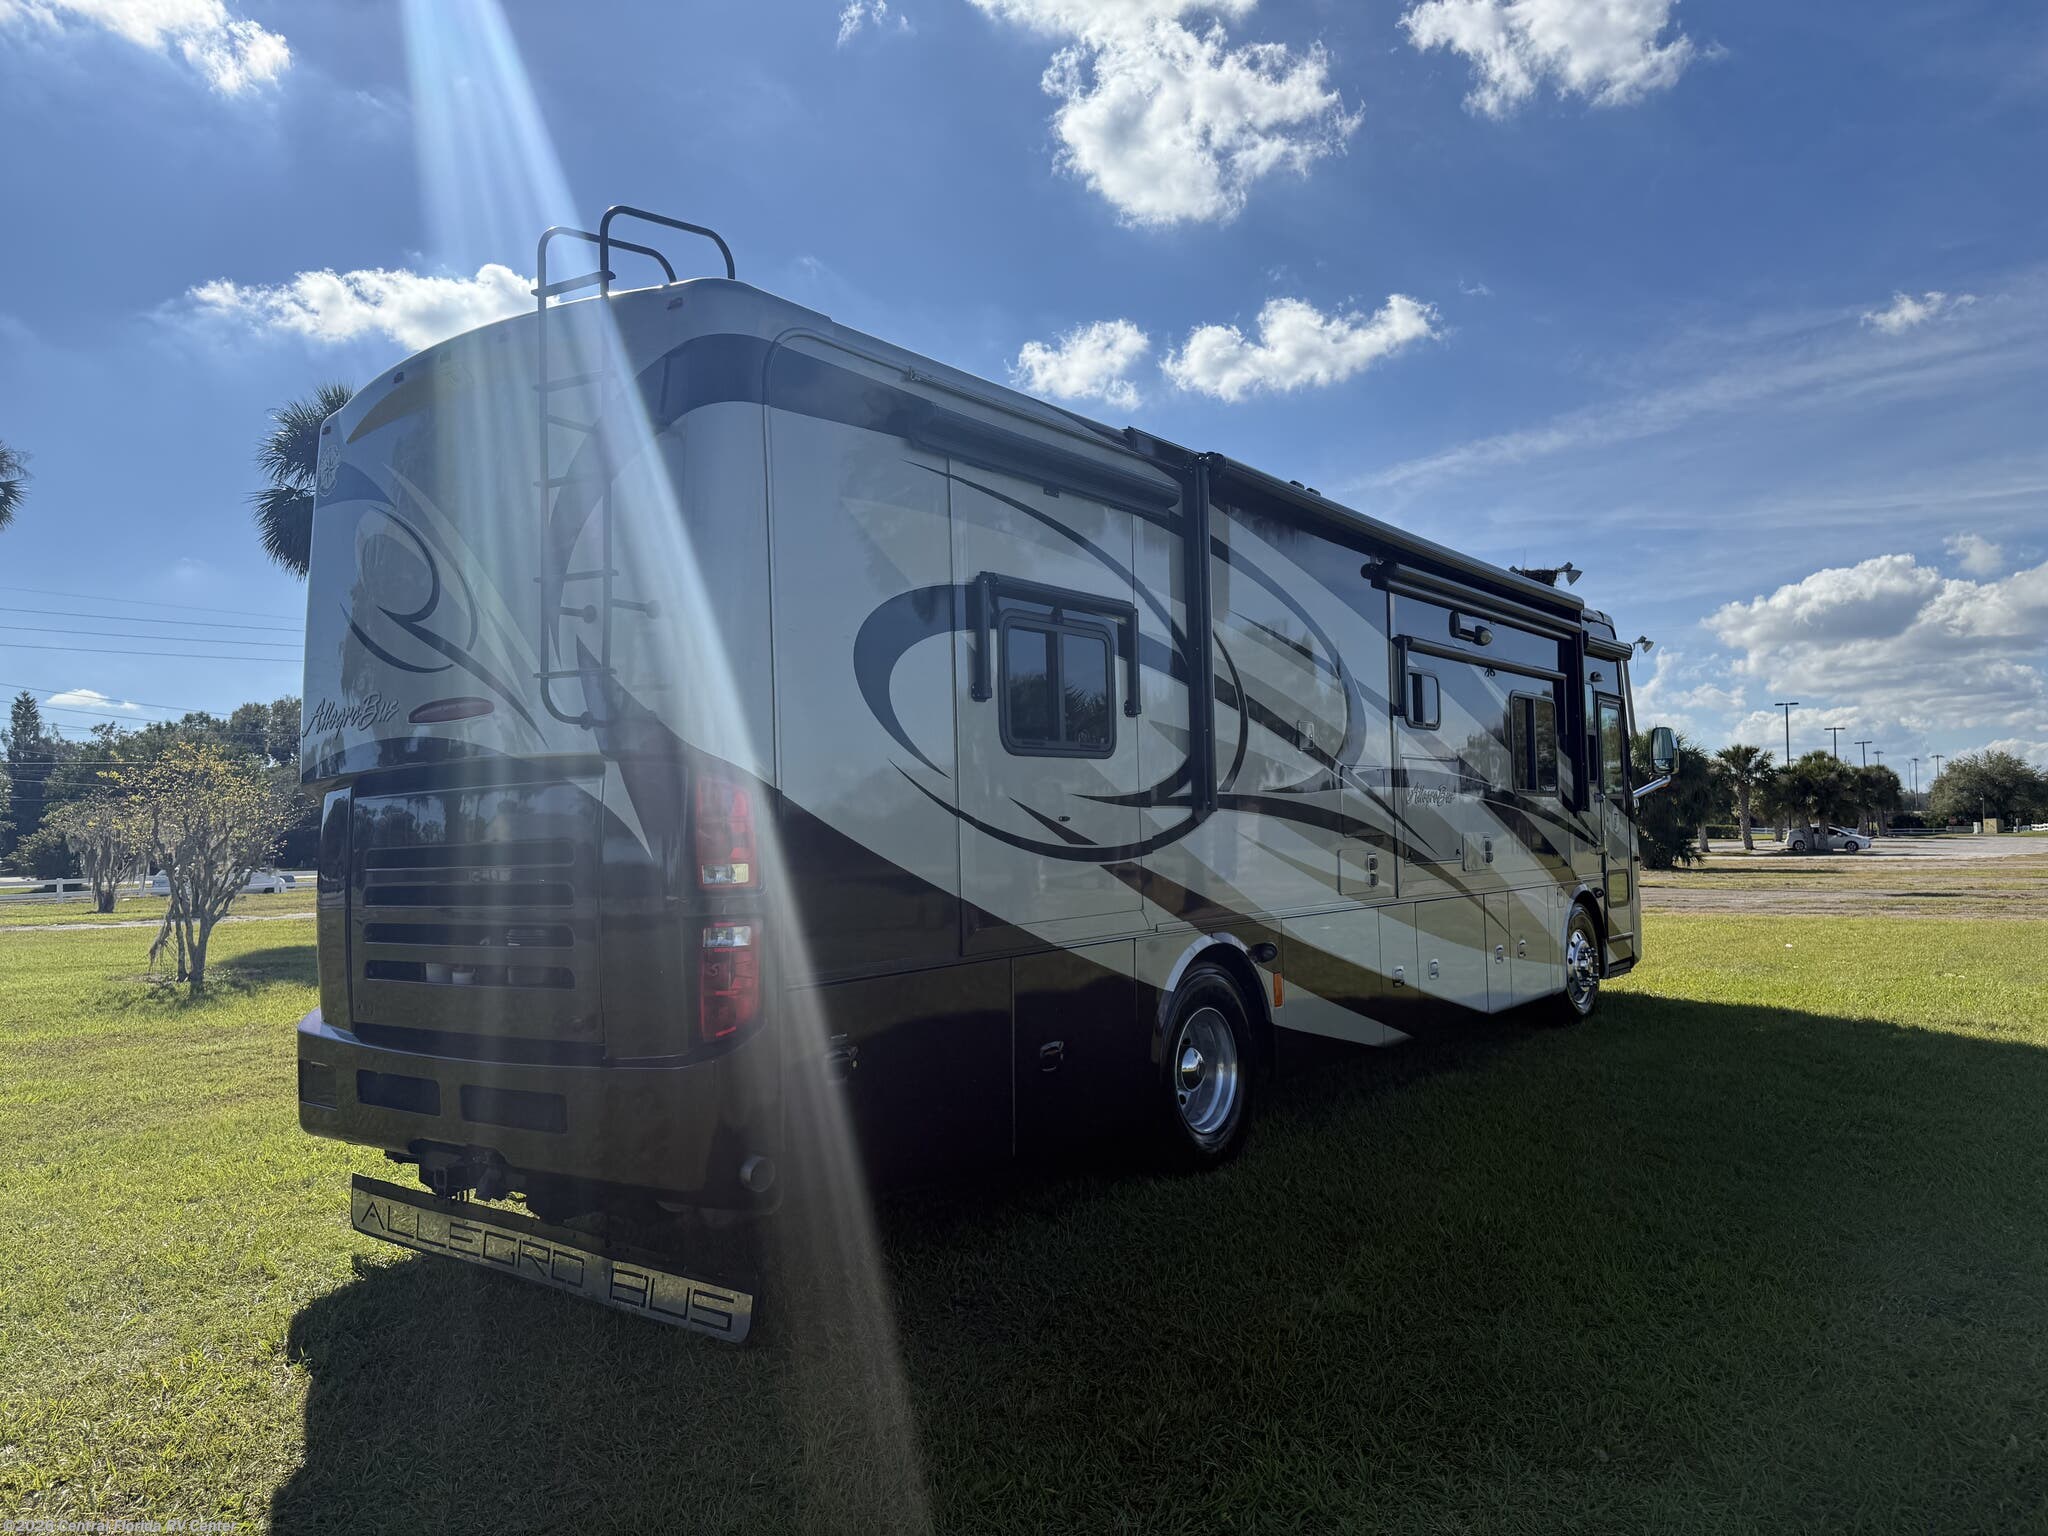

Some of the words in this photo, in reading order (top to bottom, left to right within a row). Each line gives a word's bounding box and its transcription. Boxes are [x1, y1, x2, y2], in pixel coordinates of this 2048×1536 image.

[302, 697, 362, 739] Allegro
[359, 692, 399, 731] Bus
[361, 1201, 585, 1288] ALLEGRO
[610, 1266, 735, 1332] BUS
